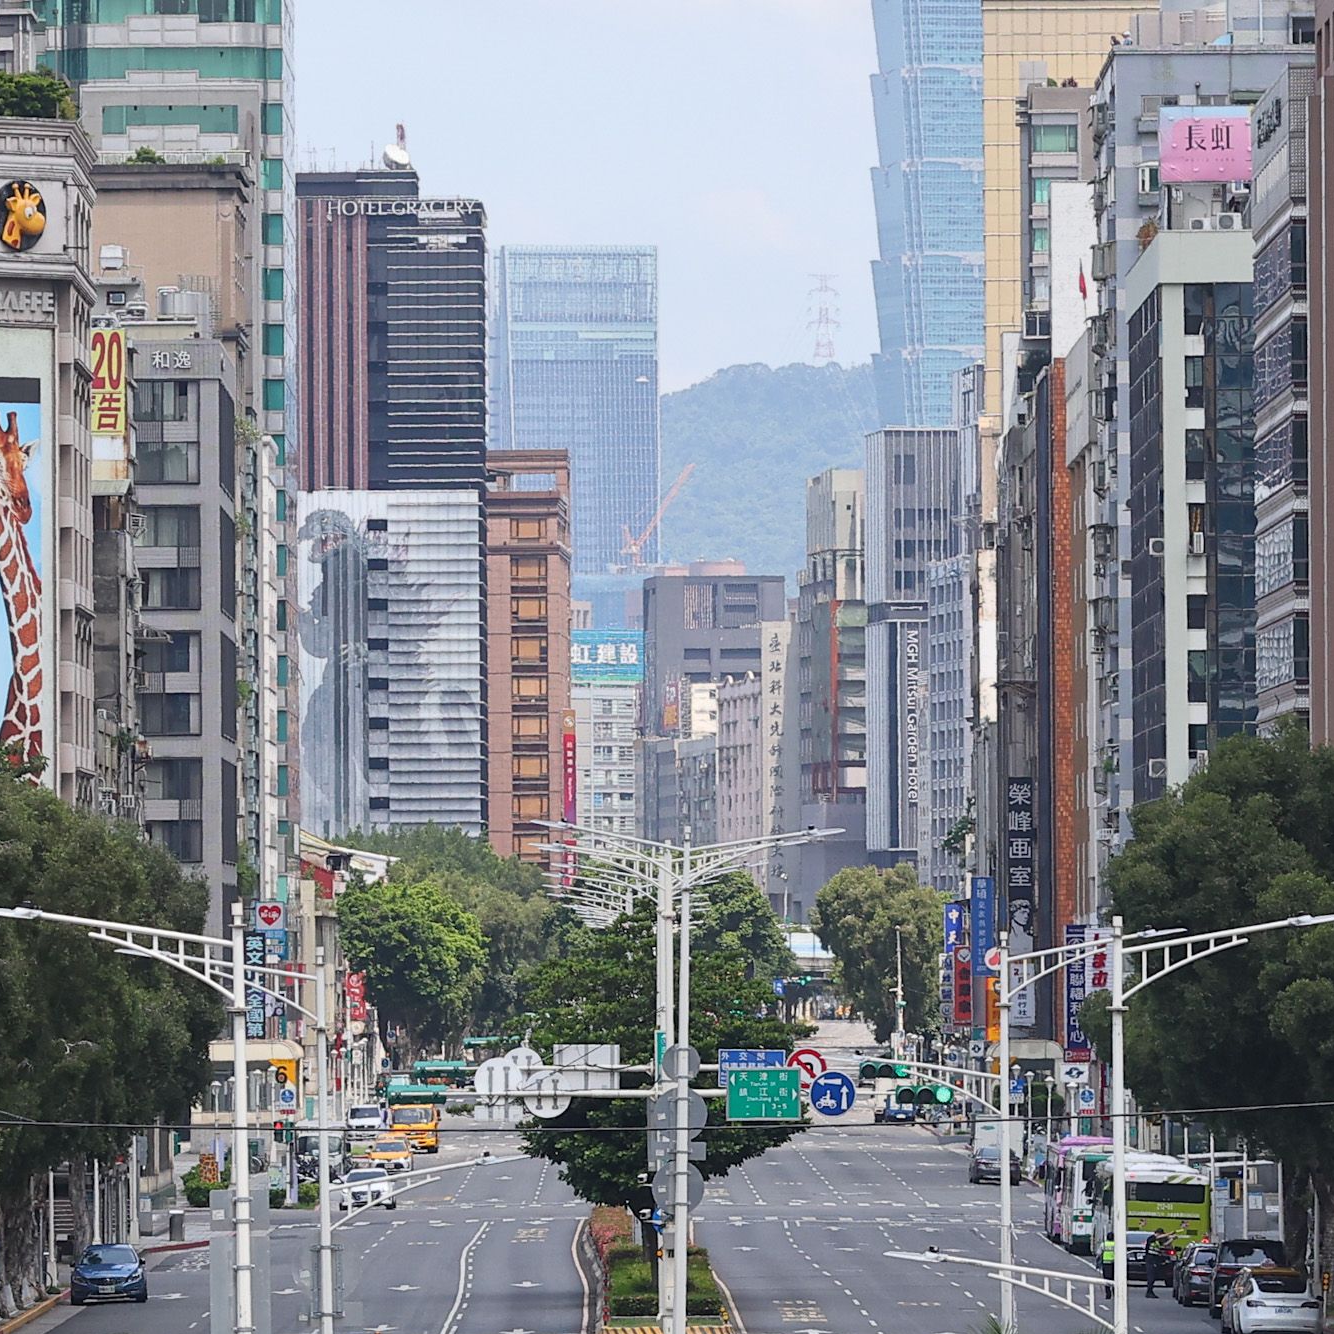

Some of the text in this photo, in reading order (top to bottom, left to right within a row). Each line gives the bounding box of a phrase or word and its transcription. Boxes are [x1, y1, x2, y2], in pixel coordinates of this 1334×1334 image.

[1185, 124, 1234, 151] 長虹
[327, 200, 477, 216] HOTEL GRACERY
[91, 331, 123, 390] 20
[152, 350, 192, 370] 和逸
[91, 392, 122, 431] 告
[907, 630, 918, 804] MGH Mitsui Garden Hotel
[1008, 783, 1033, 888] 榮峰画室
[275, 1066, 288, 1084] 6
[738, 1072, 788, 1081] 天津街
[1009, 1080, 1017, 1090] P
